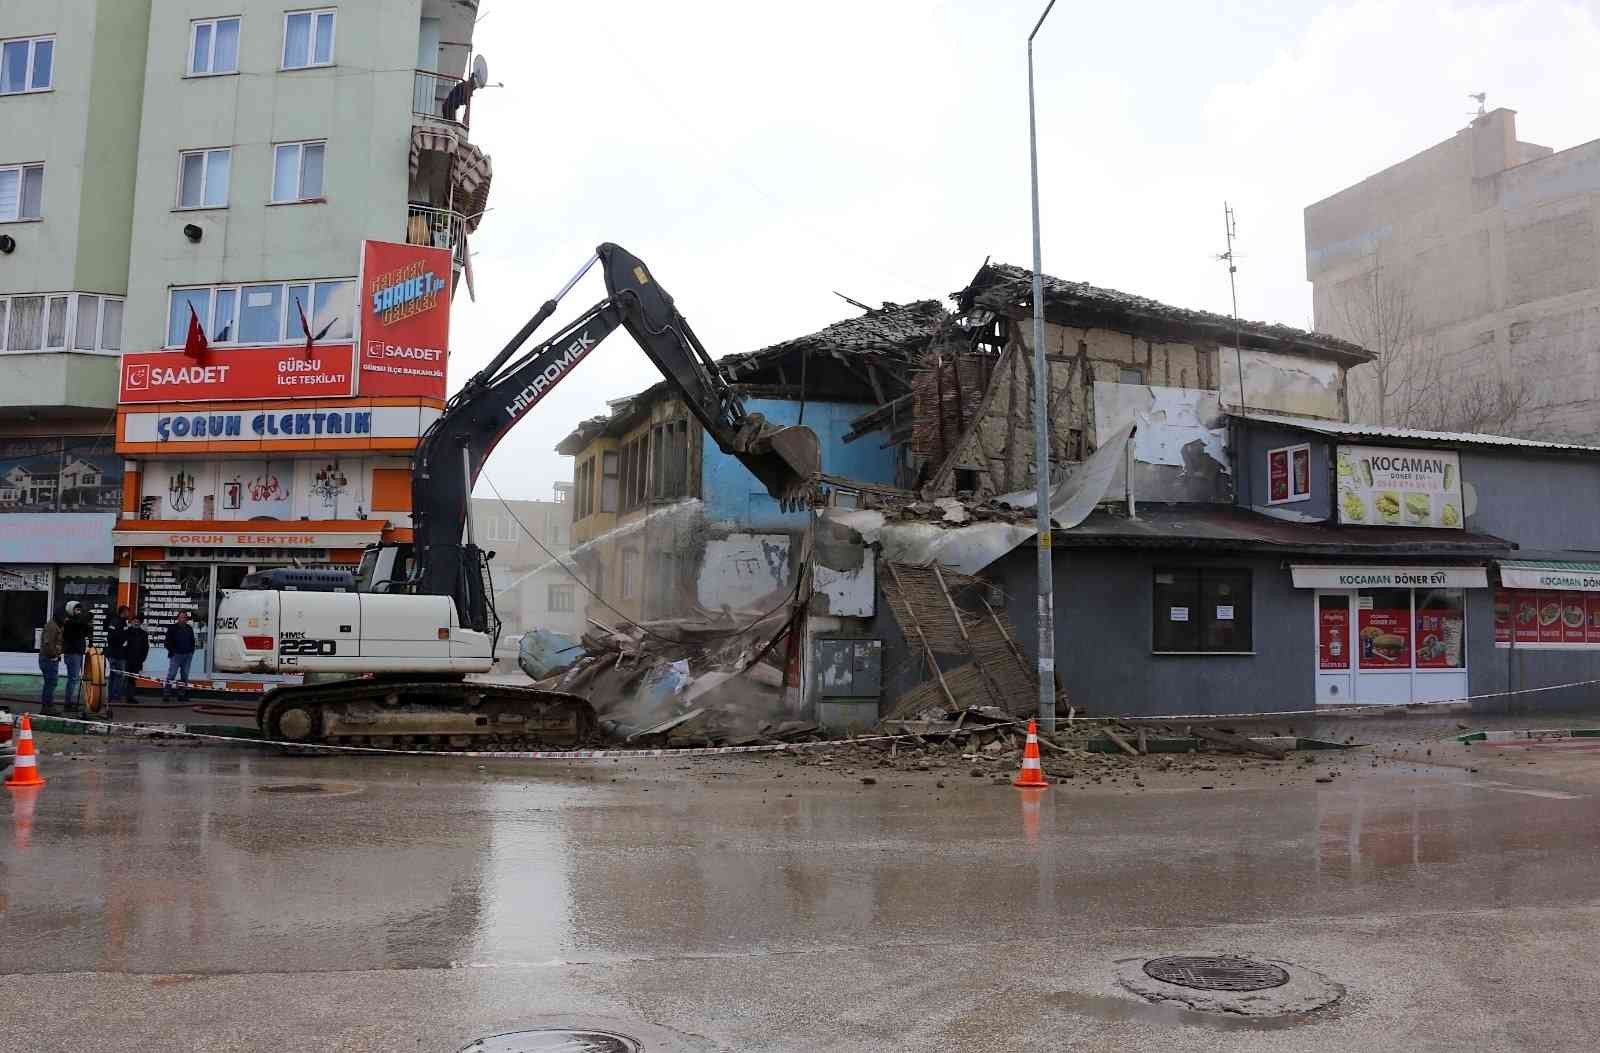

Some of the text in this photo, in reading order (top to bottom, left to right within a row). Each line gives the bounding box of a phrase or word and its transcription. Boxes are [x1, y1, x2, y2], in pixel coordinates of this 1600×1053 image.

[373, 271, 434, 313] SAADET
[385, 345, 442, 361] SAADET
[278, 358, 321, 372] GÜRSU
[151, 366, 229, 385] SAADET
[277, 373, 345, 387] İLÇE TEŞKİLATI
[1371, 456, 1443, 474] KOCAMAN
[1339, 575, 1391, 584] KOCAMAN
[1394, 572, 1428, 584] DÖNER
[279, 639, 337, 656] 220
[279, 657, 297, 666] LC
